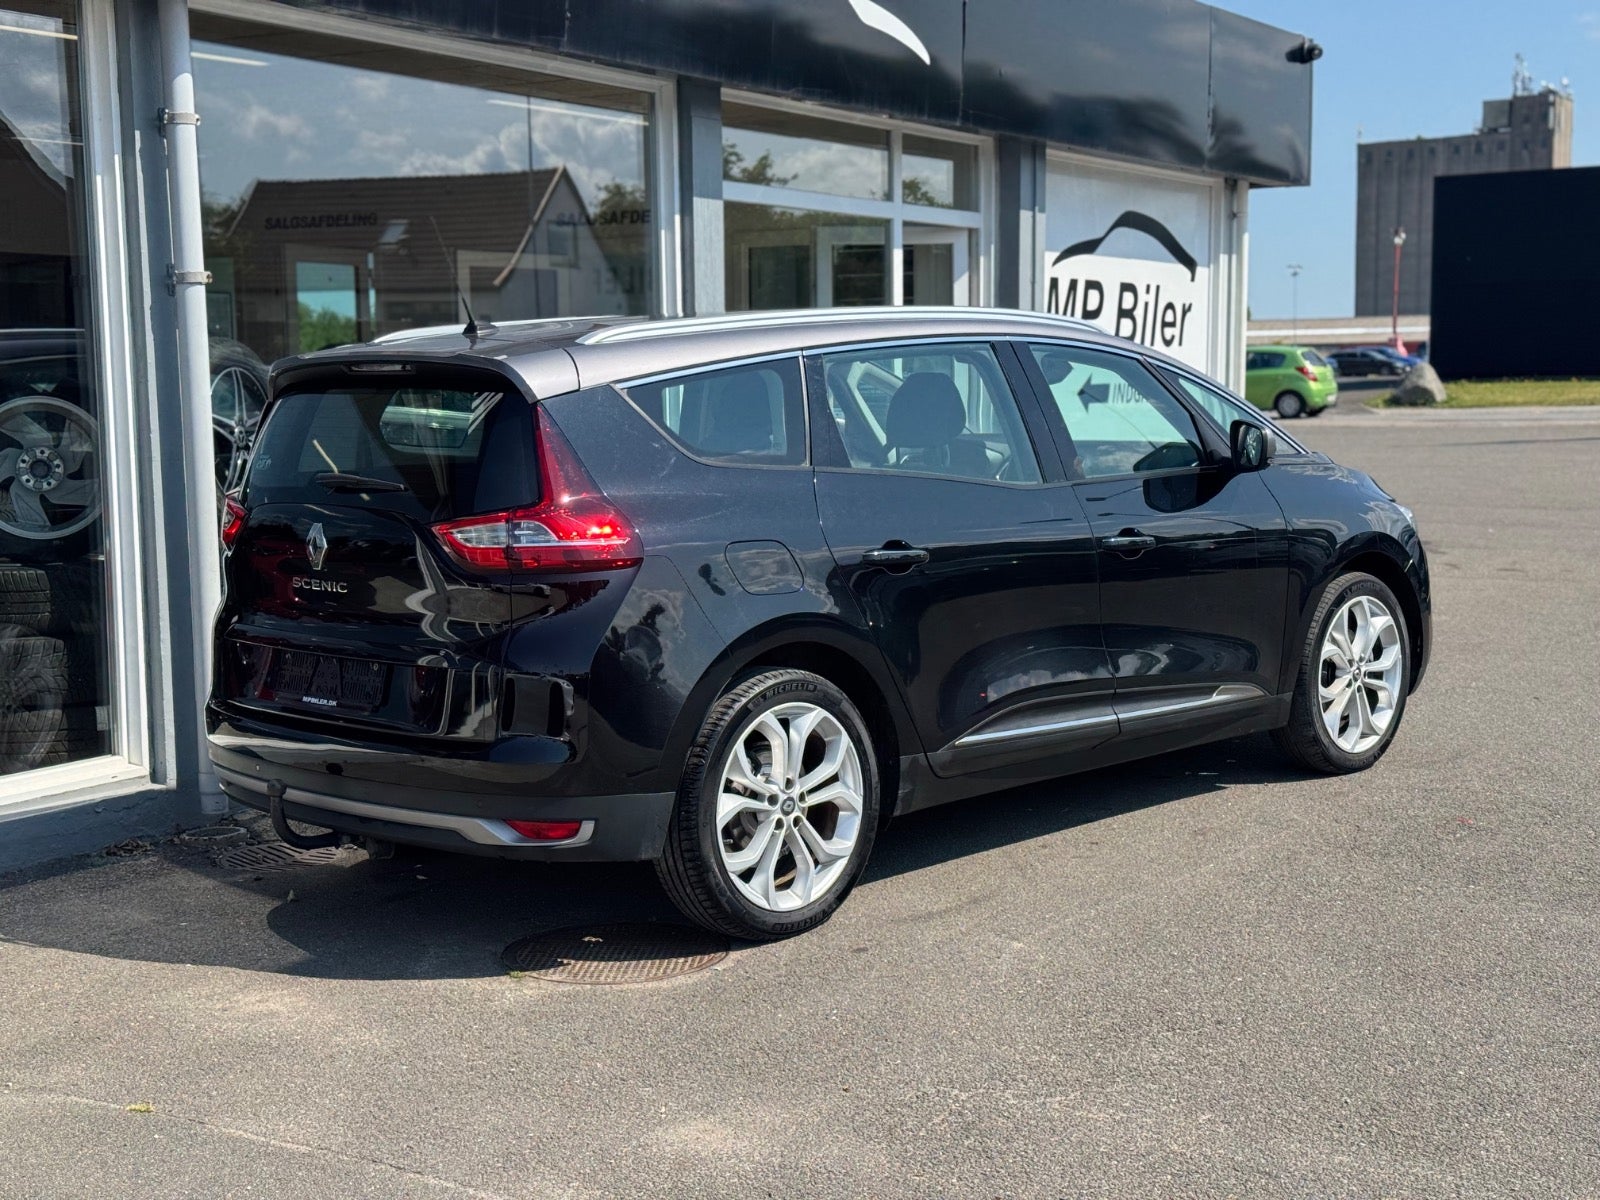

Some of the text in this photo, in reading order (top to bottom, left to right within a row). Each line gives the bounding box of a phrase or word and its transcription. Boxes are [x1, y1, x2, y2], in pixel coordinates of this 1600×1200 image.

[1047, 276, 1193, 348] MP Biler
[292, 576, 348, 593] SCENIC
